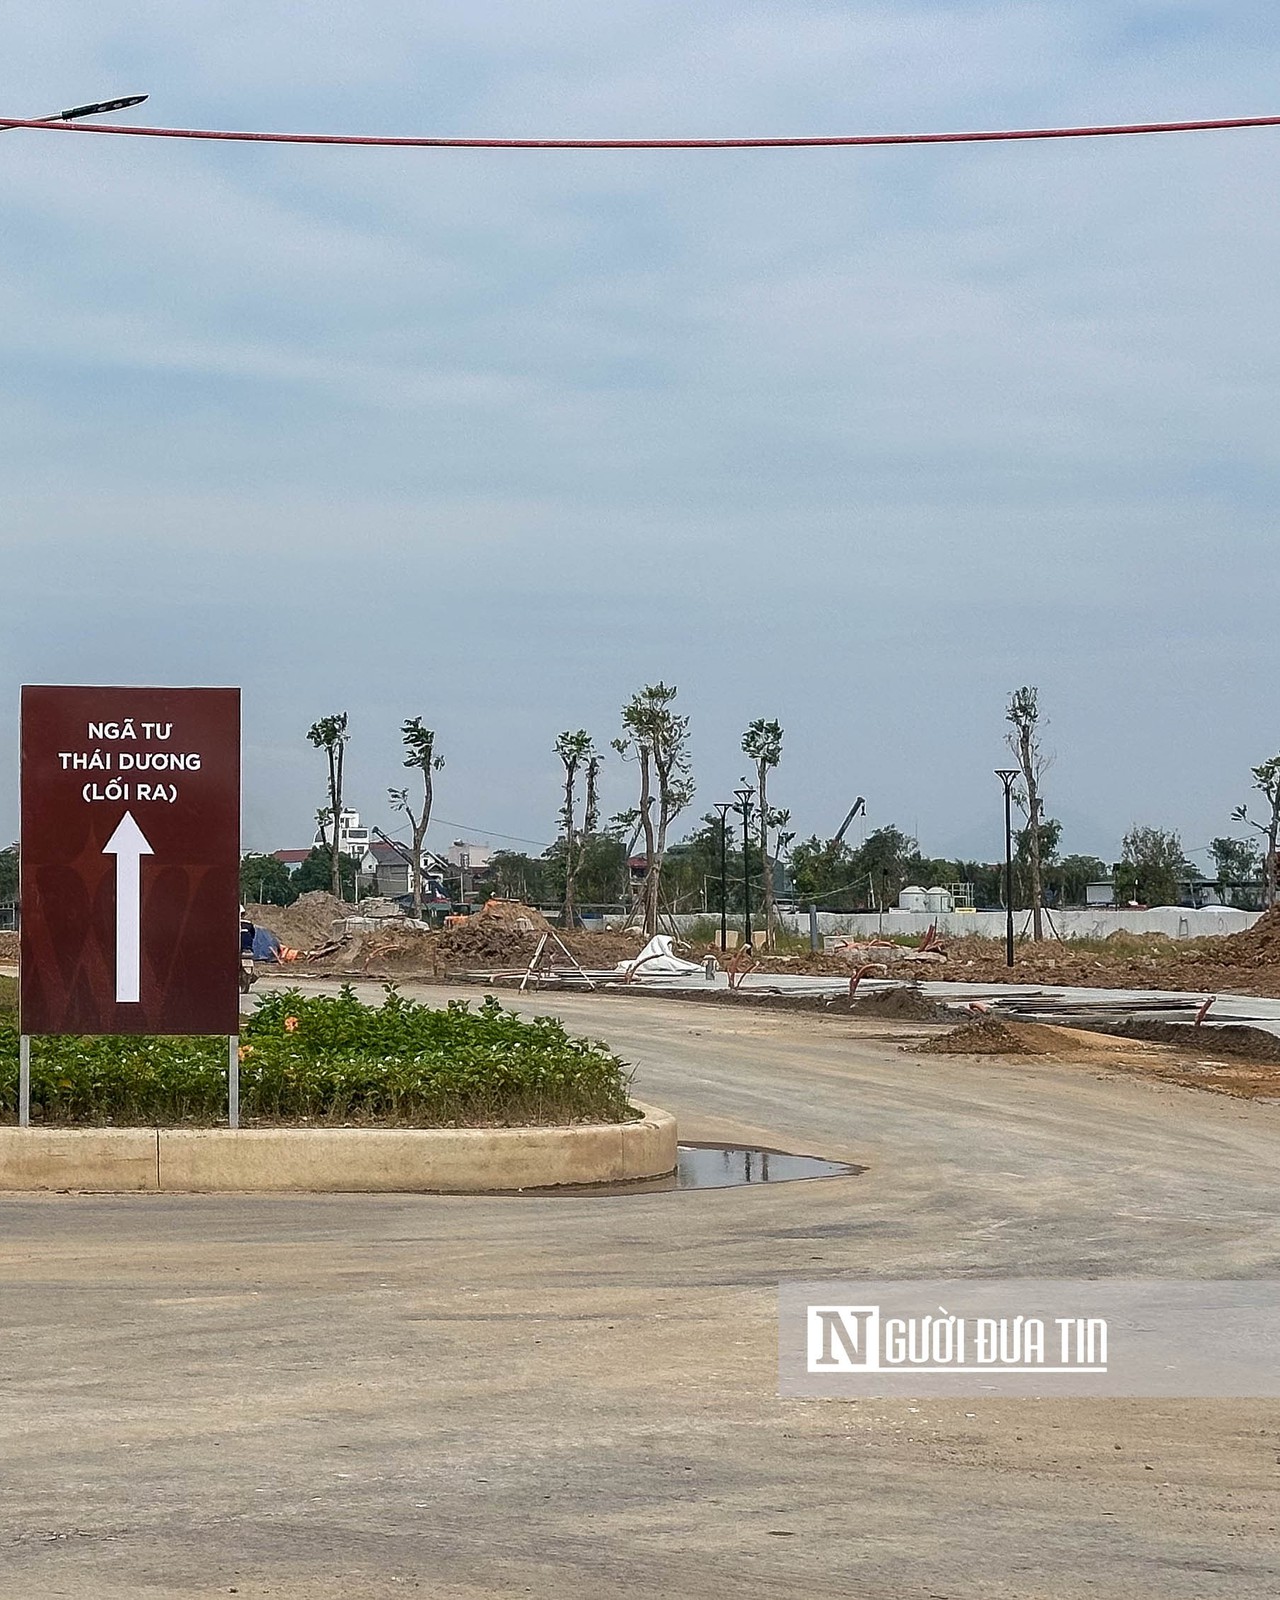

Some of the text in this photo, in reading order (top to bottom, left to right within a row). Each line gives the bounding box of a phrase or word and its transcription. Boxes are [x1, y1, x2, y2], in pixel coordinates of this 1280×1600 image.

[88, 718, 173, 740] NGÃ TƯ
[58, 748, 201, 770] THÁI DƯƠNG
[82, 776, 178, 803] (LỐI RA)
